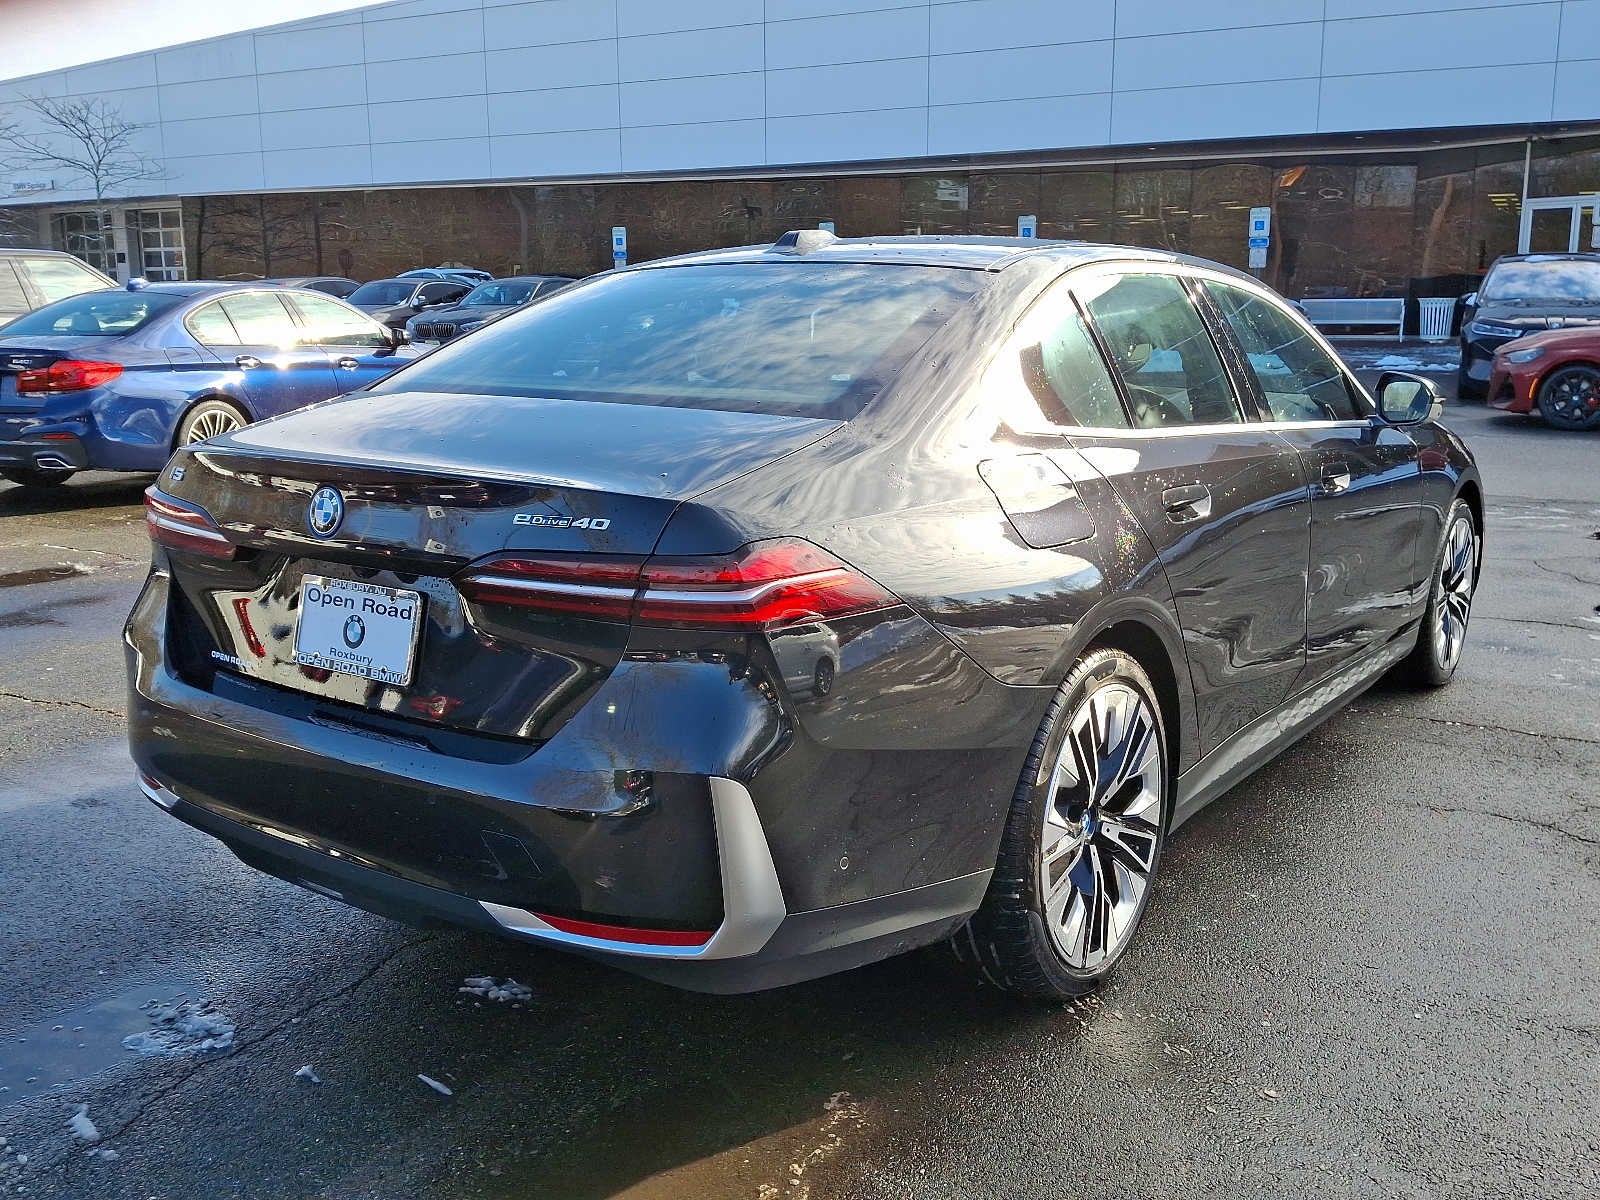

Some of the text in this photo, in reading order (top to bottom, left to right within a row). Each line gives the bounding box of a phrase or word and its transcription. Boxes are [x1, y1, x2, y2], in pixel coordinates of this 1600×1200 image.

[308, 587, 412, 621] Open Road
[211, 650, 252, 669] OPEN ROAD
[329, 647, 373, 666] Roxbury
[298, 654, 402, 684] OPEN ROAD BMW
